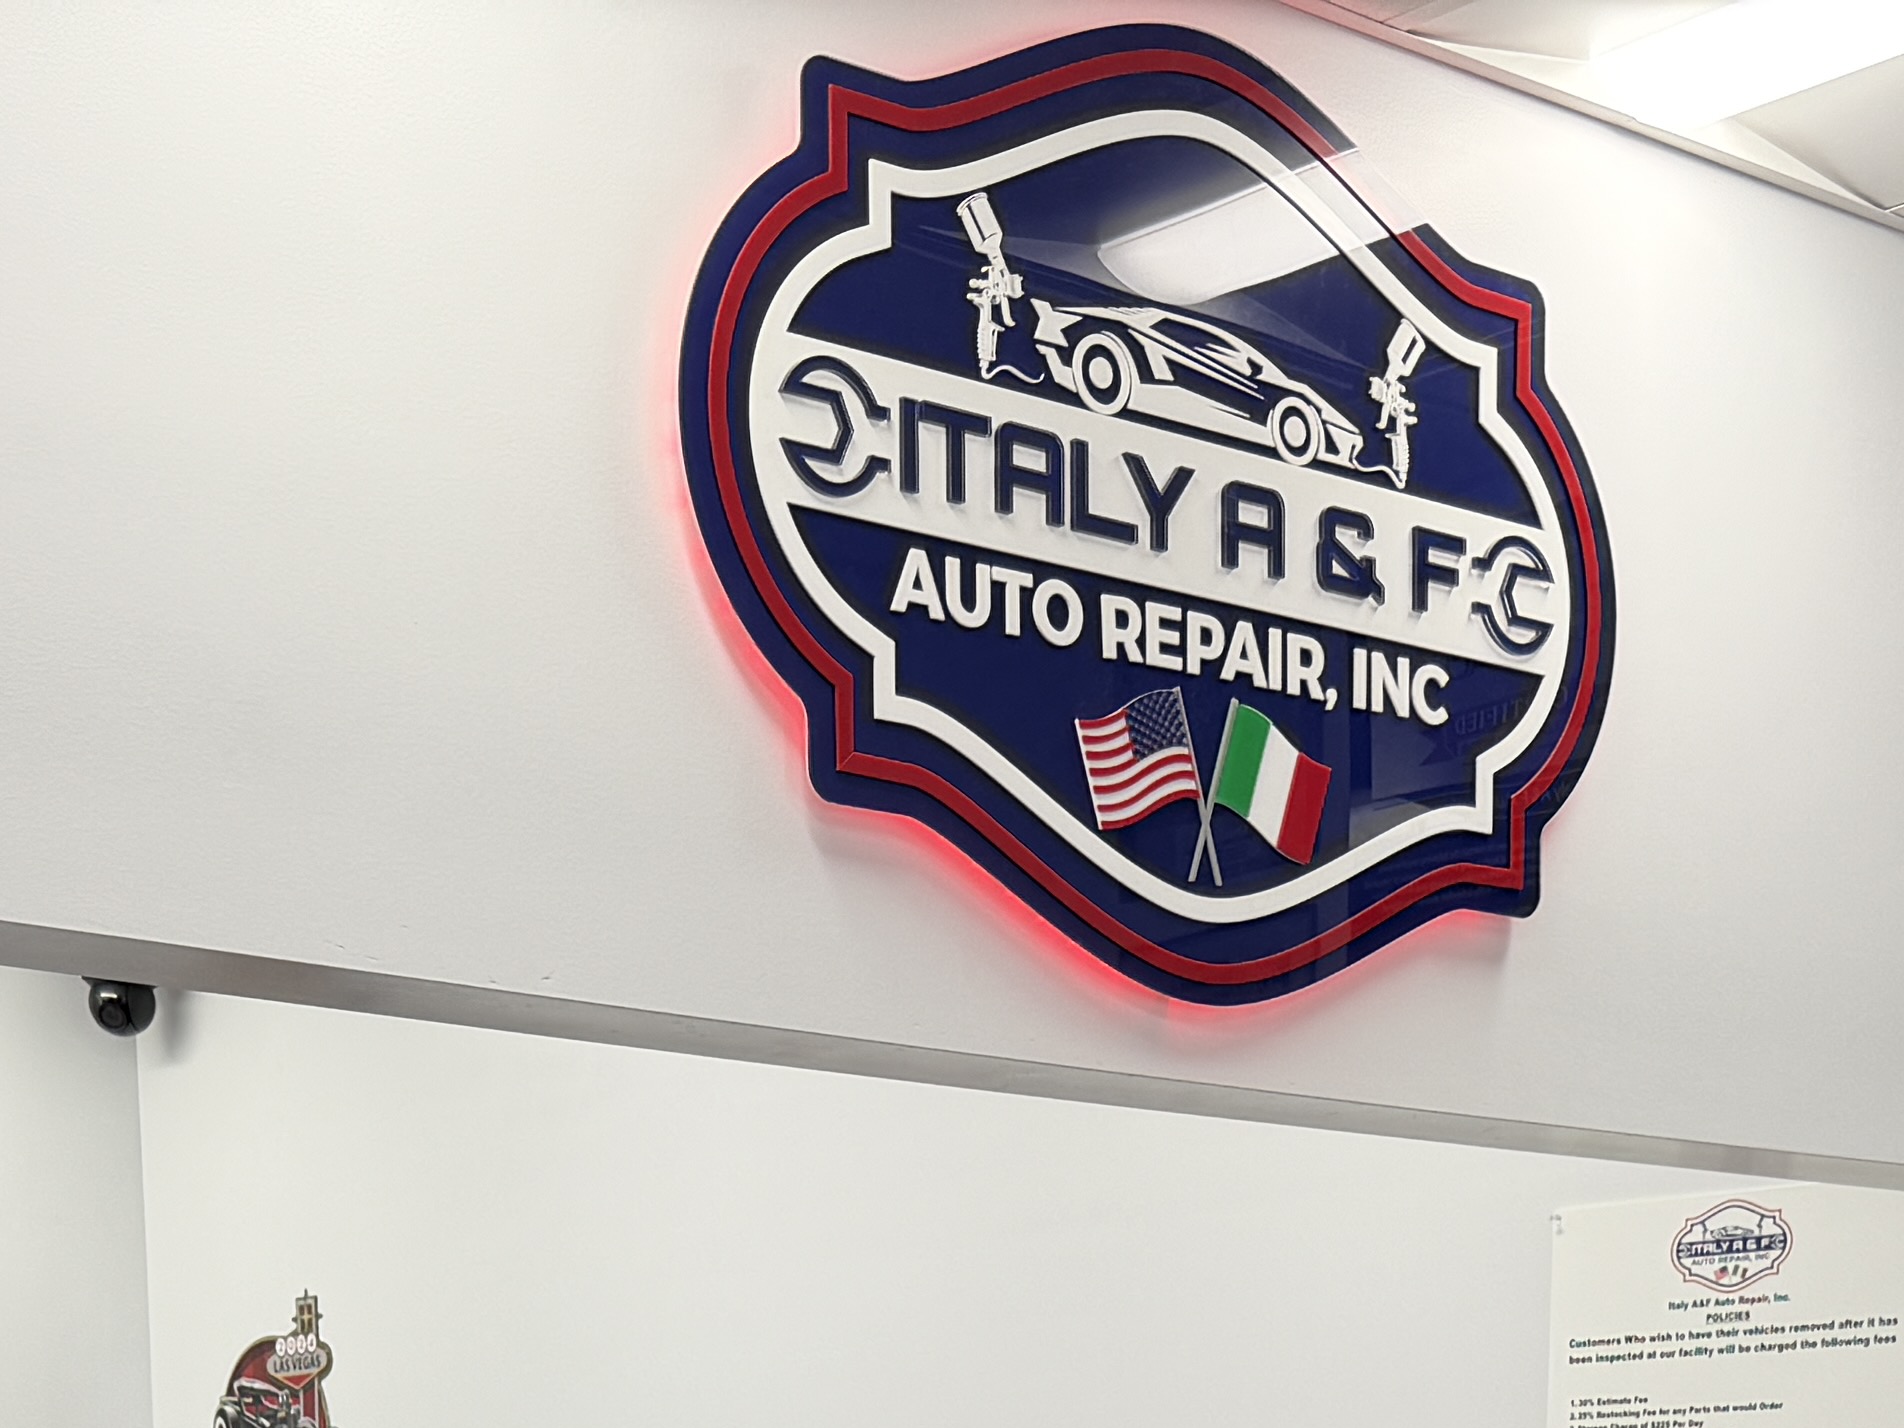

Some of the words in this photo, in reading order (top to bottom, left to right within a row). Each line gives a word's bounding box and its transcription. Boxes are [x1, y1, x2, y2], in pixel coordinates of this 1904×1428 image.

[898, 397, 1195, 554] ITALY
[1221, 479, 1286, 581] A
[1316, 511, 1384, 605] &
[1411, 530, 1468, 613] F
[891, 550, 1083, 649] AUTO
[1101, 593, 1337, 713] REPAIR,
[1353, 649, 1449, 726] INC
[273, 1356, 290, 1373] LAS
[292, 1354, 322, 1372] VEGAS
